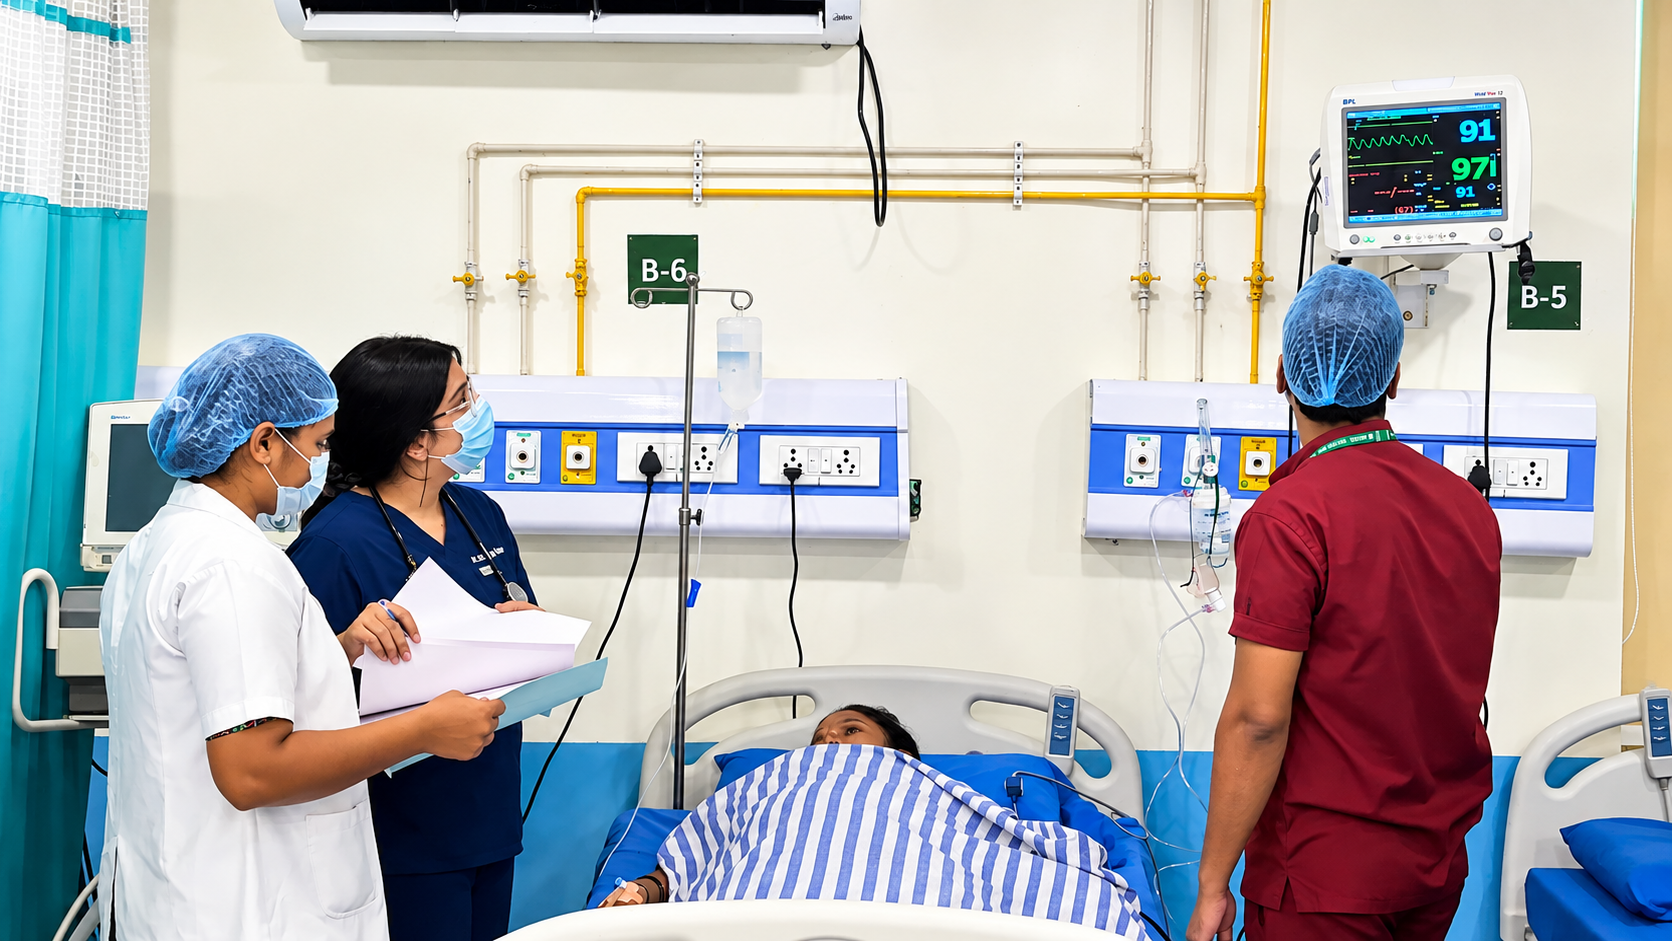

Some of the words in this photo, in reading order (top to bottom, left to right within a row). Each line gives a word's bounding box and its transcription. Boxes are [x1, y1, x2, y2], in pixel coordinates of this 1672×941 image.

[1459, 118, 1496, 143] 91
[1451, 156, 1490, 181] 97
[1455, 186, 1476, 199] 91
[641, 258, 687, 282] B-6
[1521, 285, 1567, 309] B-5
